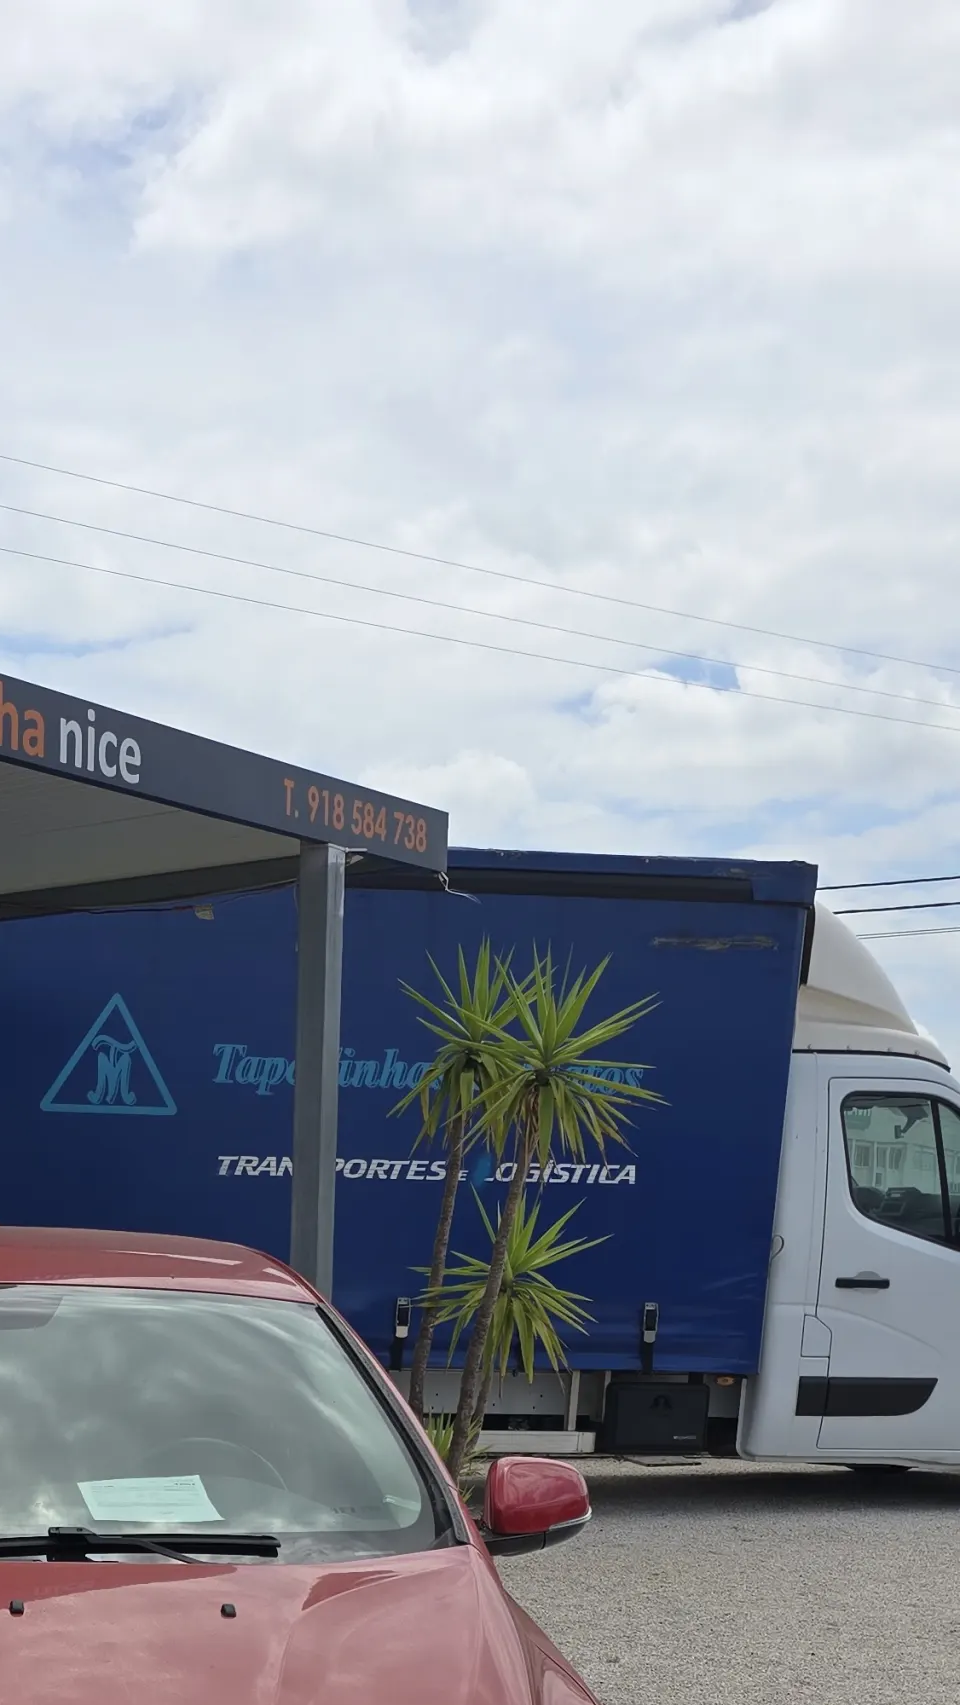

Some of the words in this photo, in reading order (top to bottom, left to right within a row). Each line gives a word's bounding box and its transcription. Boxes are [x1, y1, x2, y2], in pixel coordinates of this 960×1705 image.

[59, 709, 142, 784] nice
[283, 778, 300, 819] T.
[307, 785, 345, 830] 918
[351, 799, 388, 842] 584
[393, 811, 428, 853] 738
